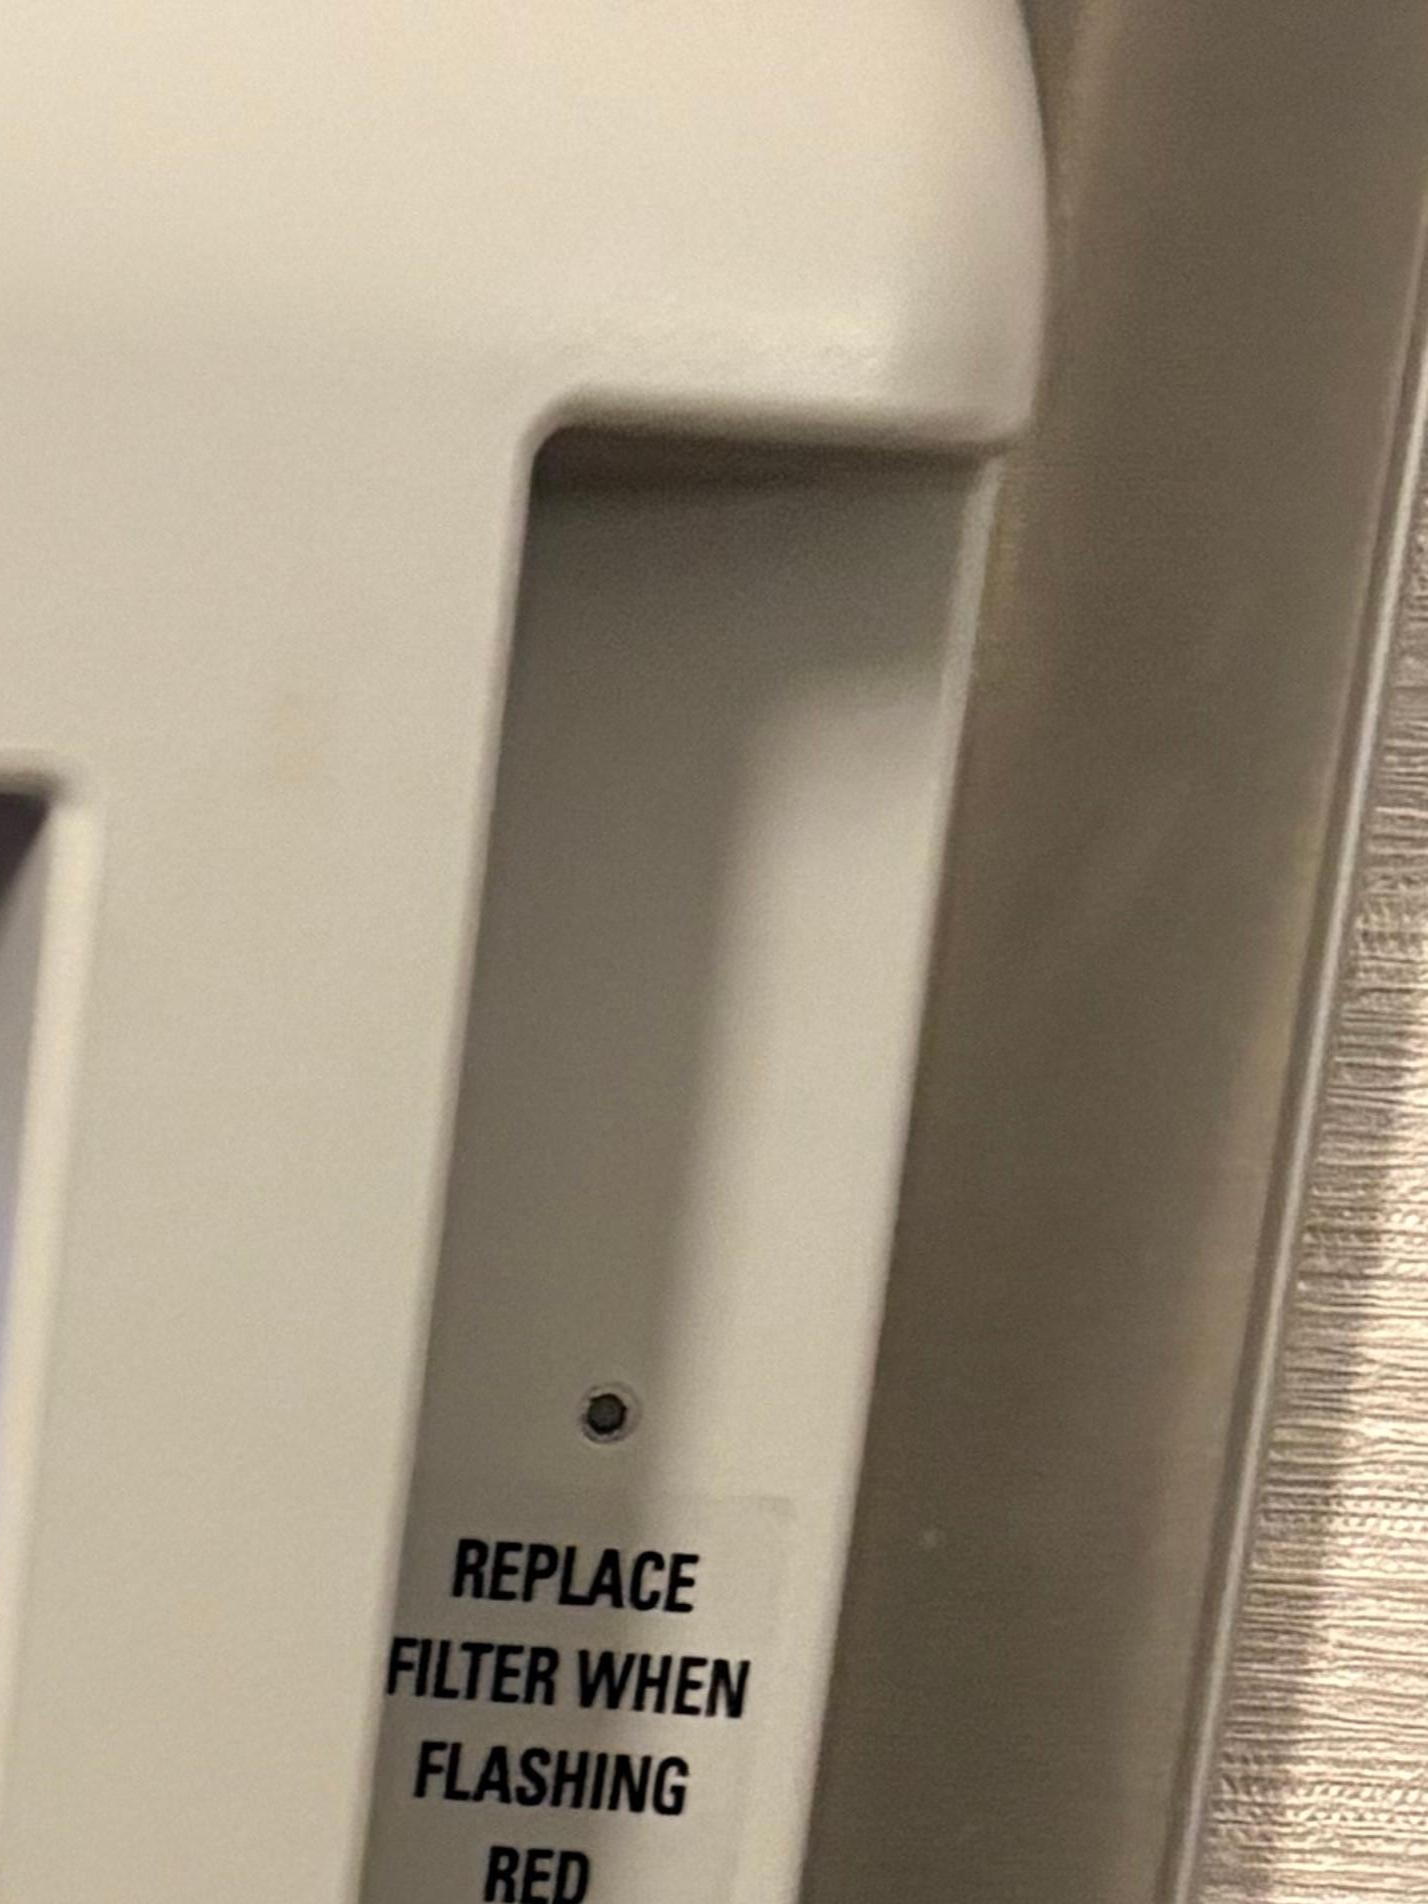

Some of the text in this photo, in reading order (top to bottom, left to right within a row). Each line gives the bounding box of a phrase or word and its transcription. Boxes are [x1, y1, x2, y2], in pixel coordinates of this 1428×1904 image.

[451, 1538, 700, 1613] REPLACE
[386, 1636, 751, 1719] FILTER WHEN
[413, 1740, 690, 1816] FLASHING
